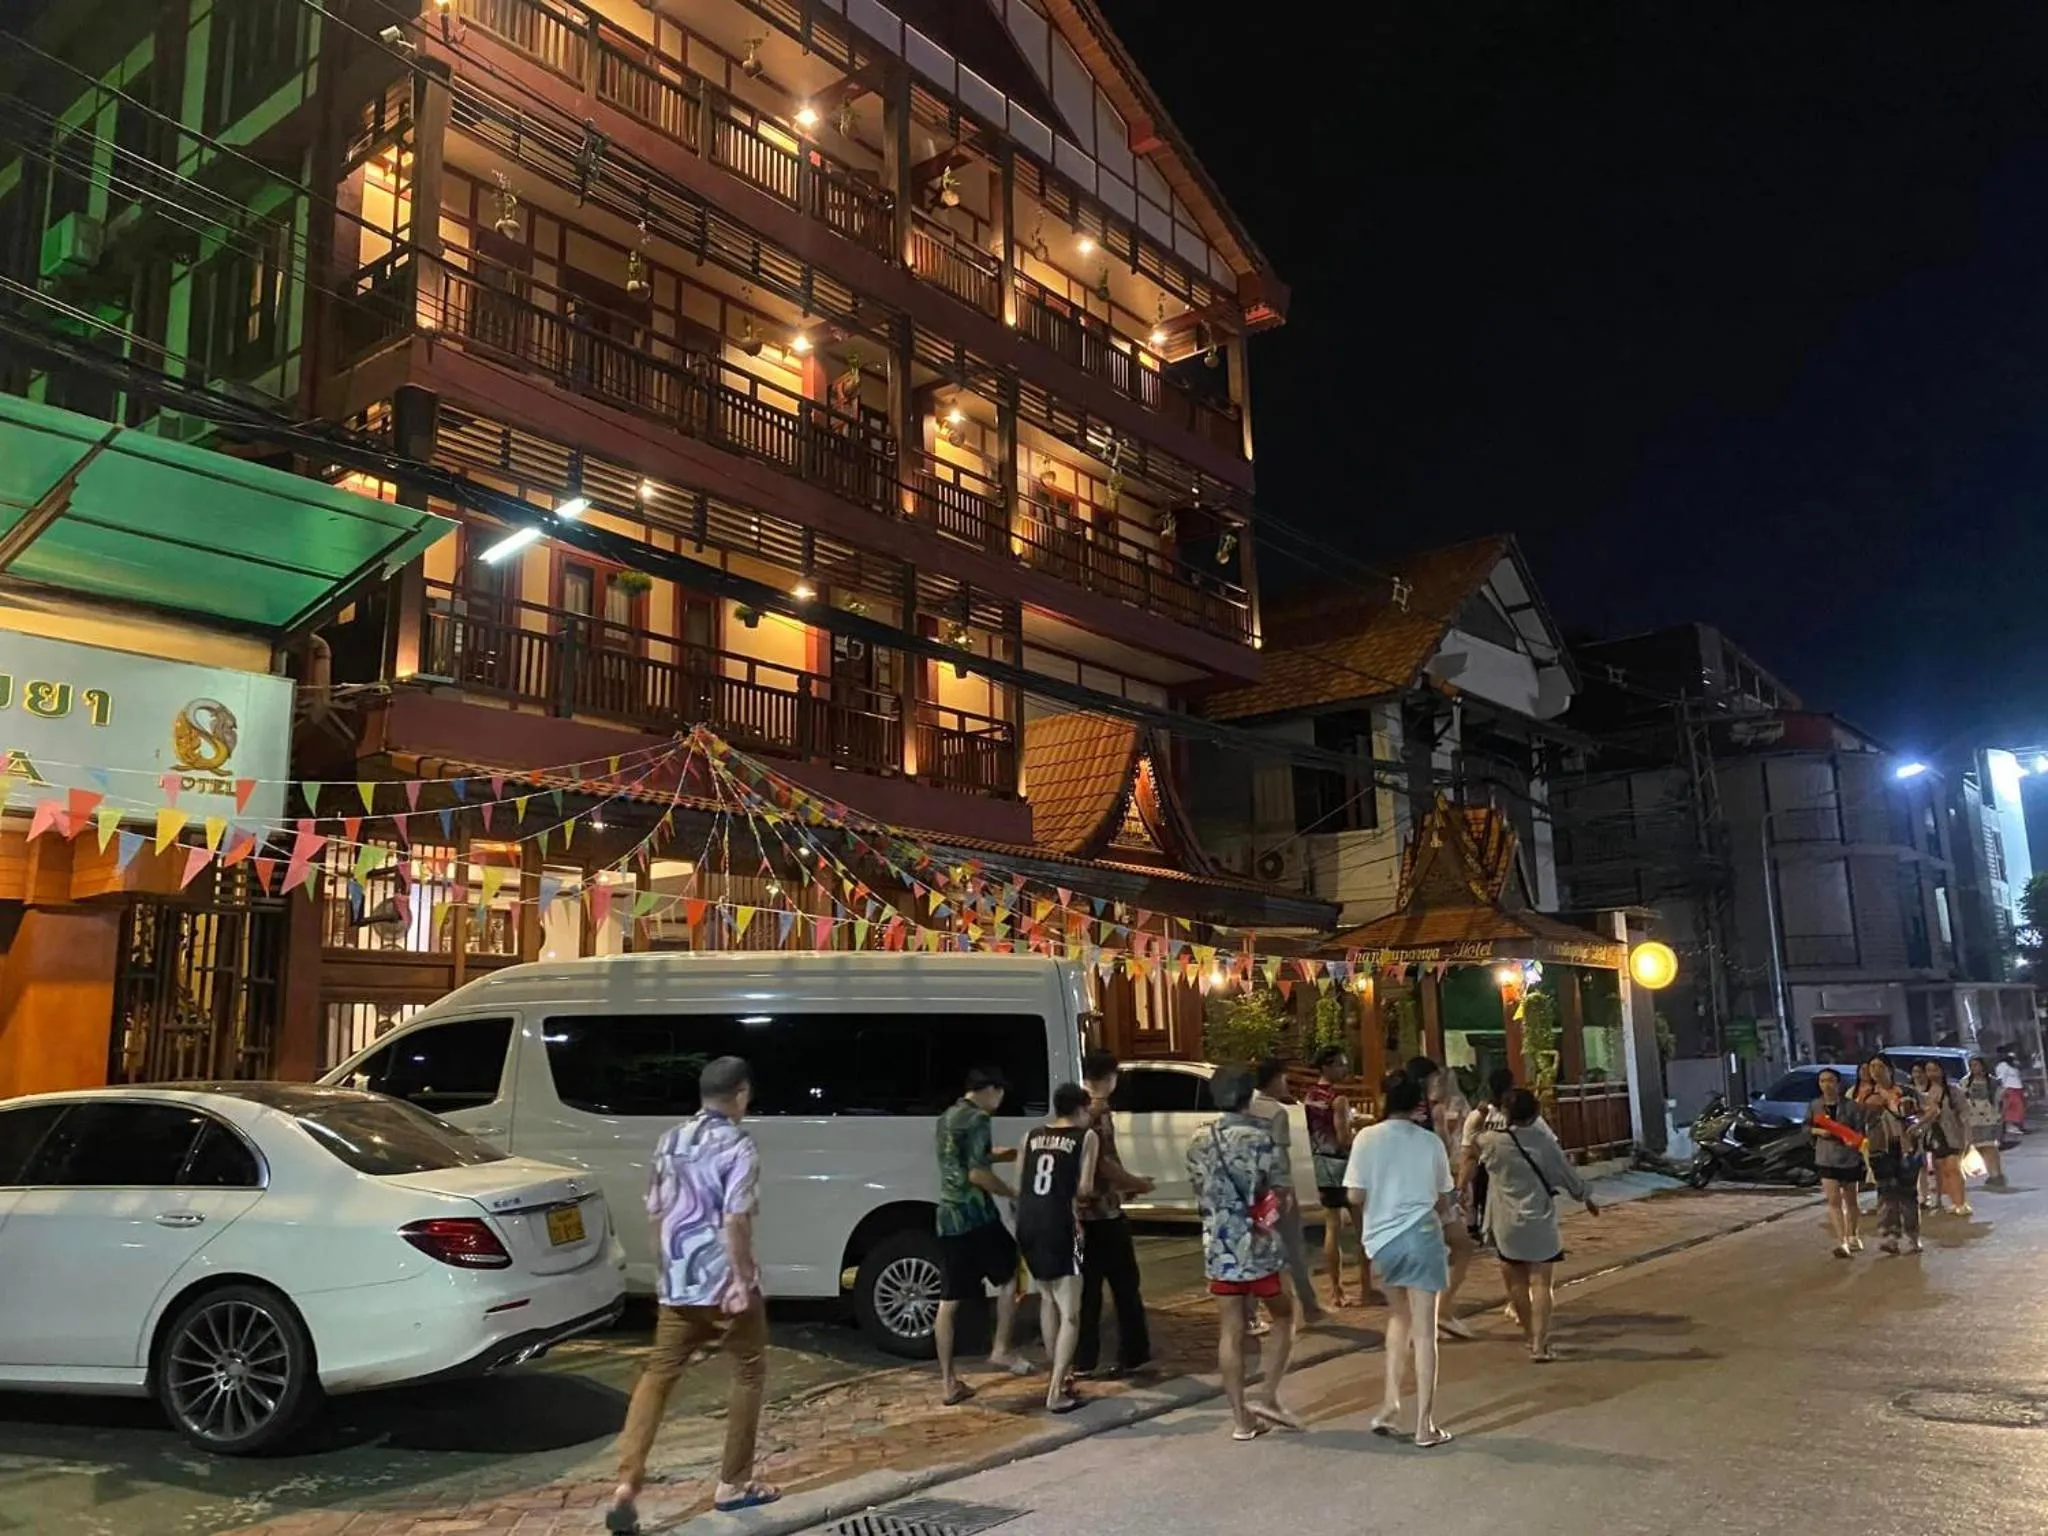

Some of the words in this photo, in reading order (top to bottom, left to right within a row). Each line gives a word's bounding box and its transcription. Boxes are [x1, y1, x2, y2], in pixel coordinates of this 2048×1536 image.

[158, 775, 237, 797] OTEL
[1453, 941, 1494, 959] Hotel
[1033, 1153, 1055, 1196] 8
